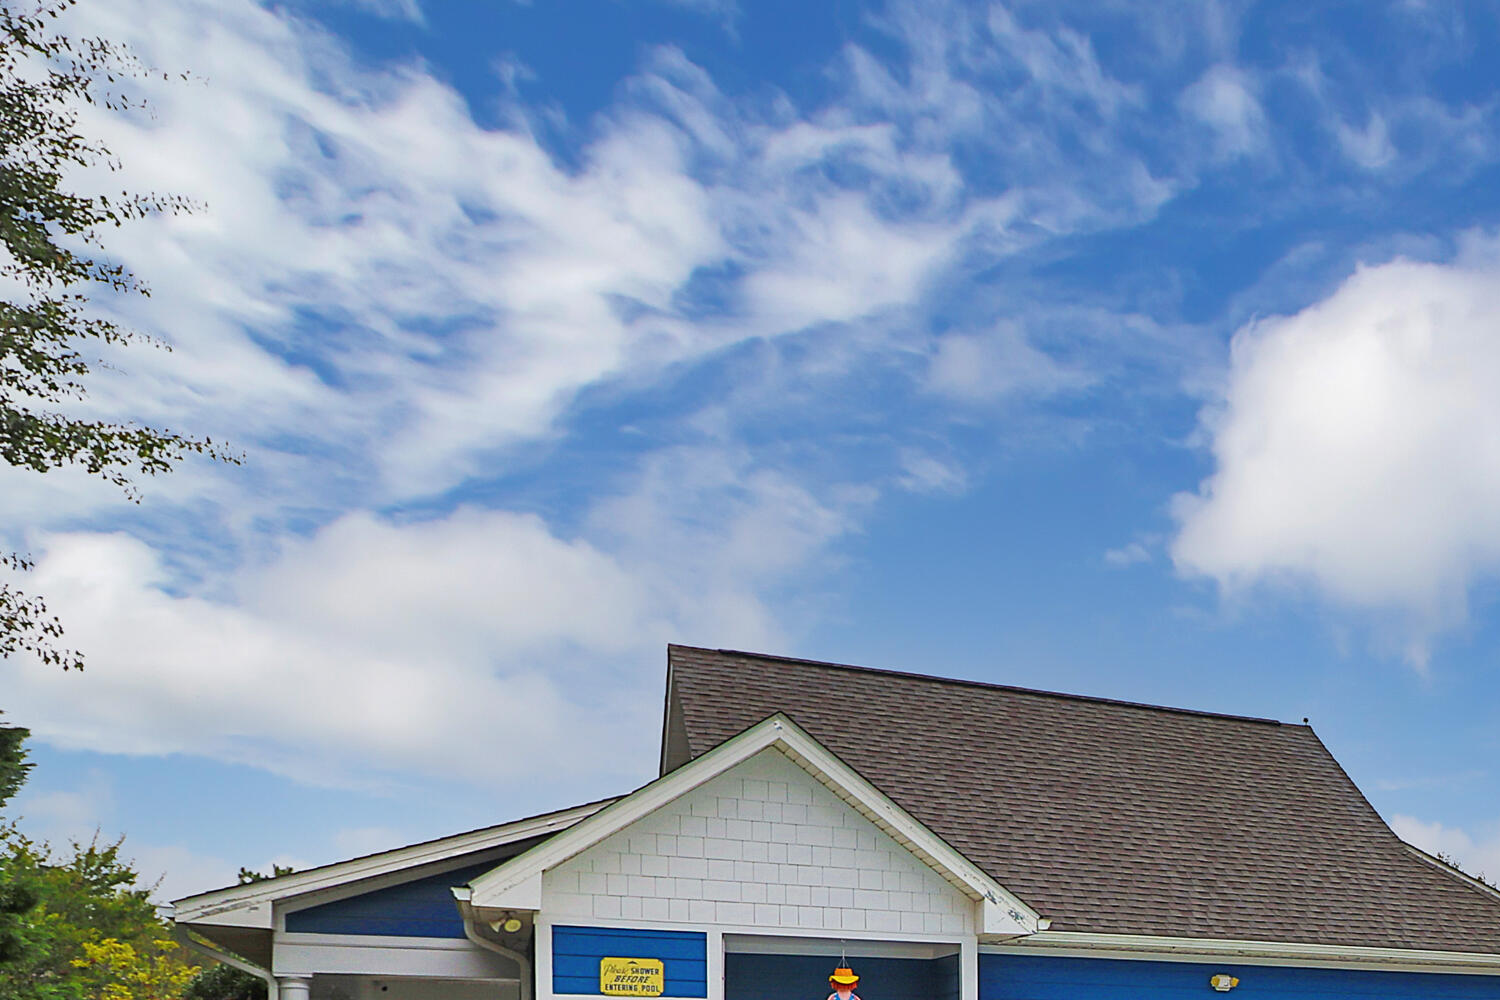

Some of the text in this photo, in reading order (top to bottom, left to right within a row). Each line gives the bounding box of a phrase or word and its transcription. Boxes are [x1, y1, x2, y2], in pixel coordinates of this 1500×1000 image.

[631, 967, 660, 975] SHOWER
[614, 975, 650, 983] BEFORE
[605, 984, 660, 993] ENTERING POOL
